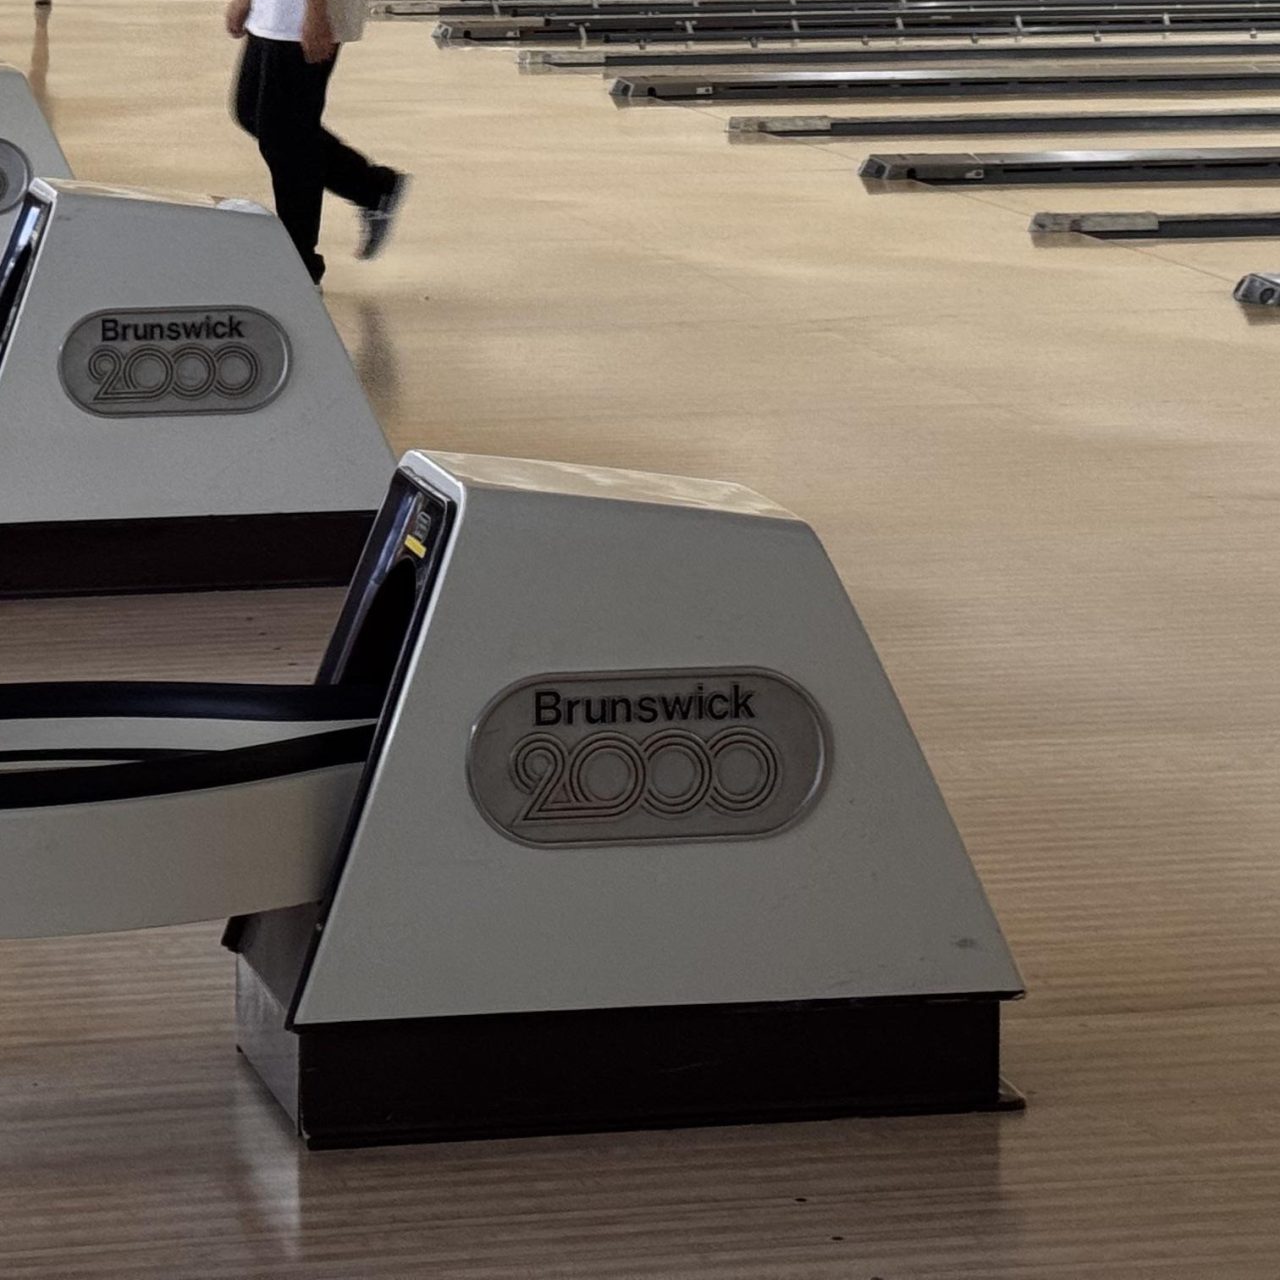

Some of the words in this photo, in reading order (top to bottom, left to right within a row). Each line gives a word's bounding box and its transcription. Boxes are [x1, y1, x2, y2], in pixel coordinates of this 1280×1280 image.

[101, 315, 244, 342] Brunswick
[87, 342, 261, 404] 2000
[533, 683, 756, 726] Brunswick
[509, 726, 782, 826] 2000
